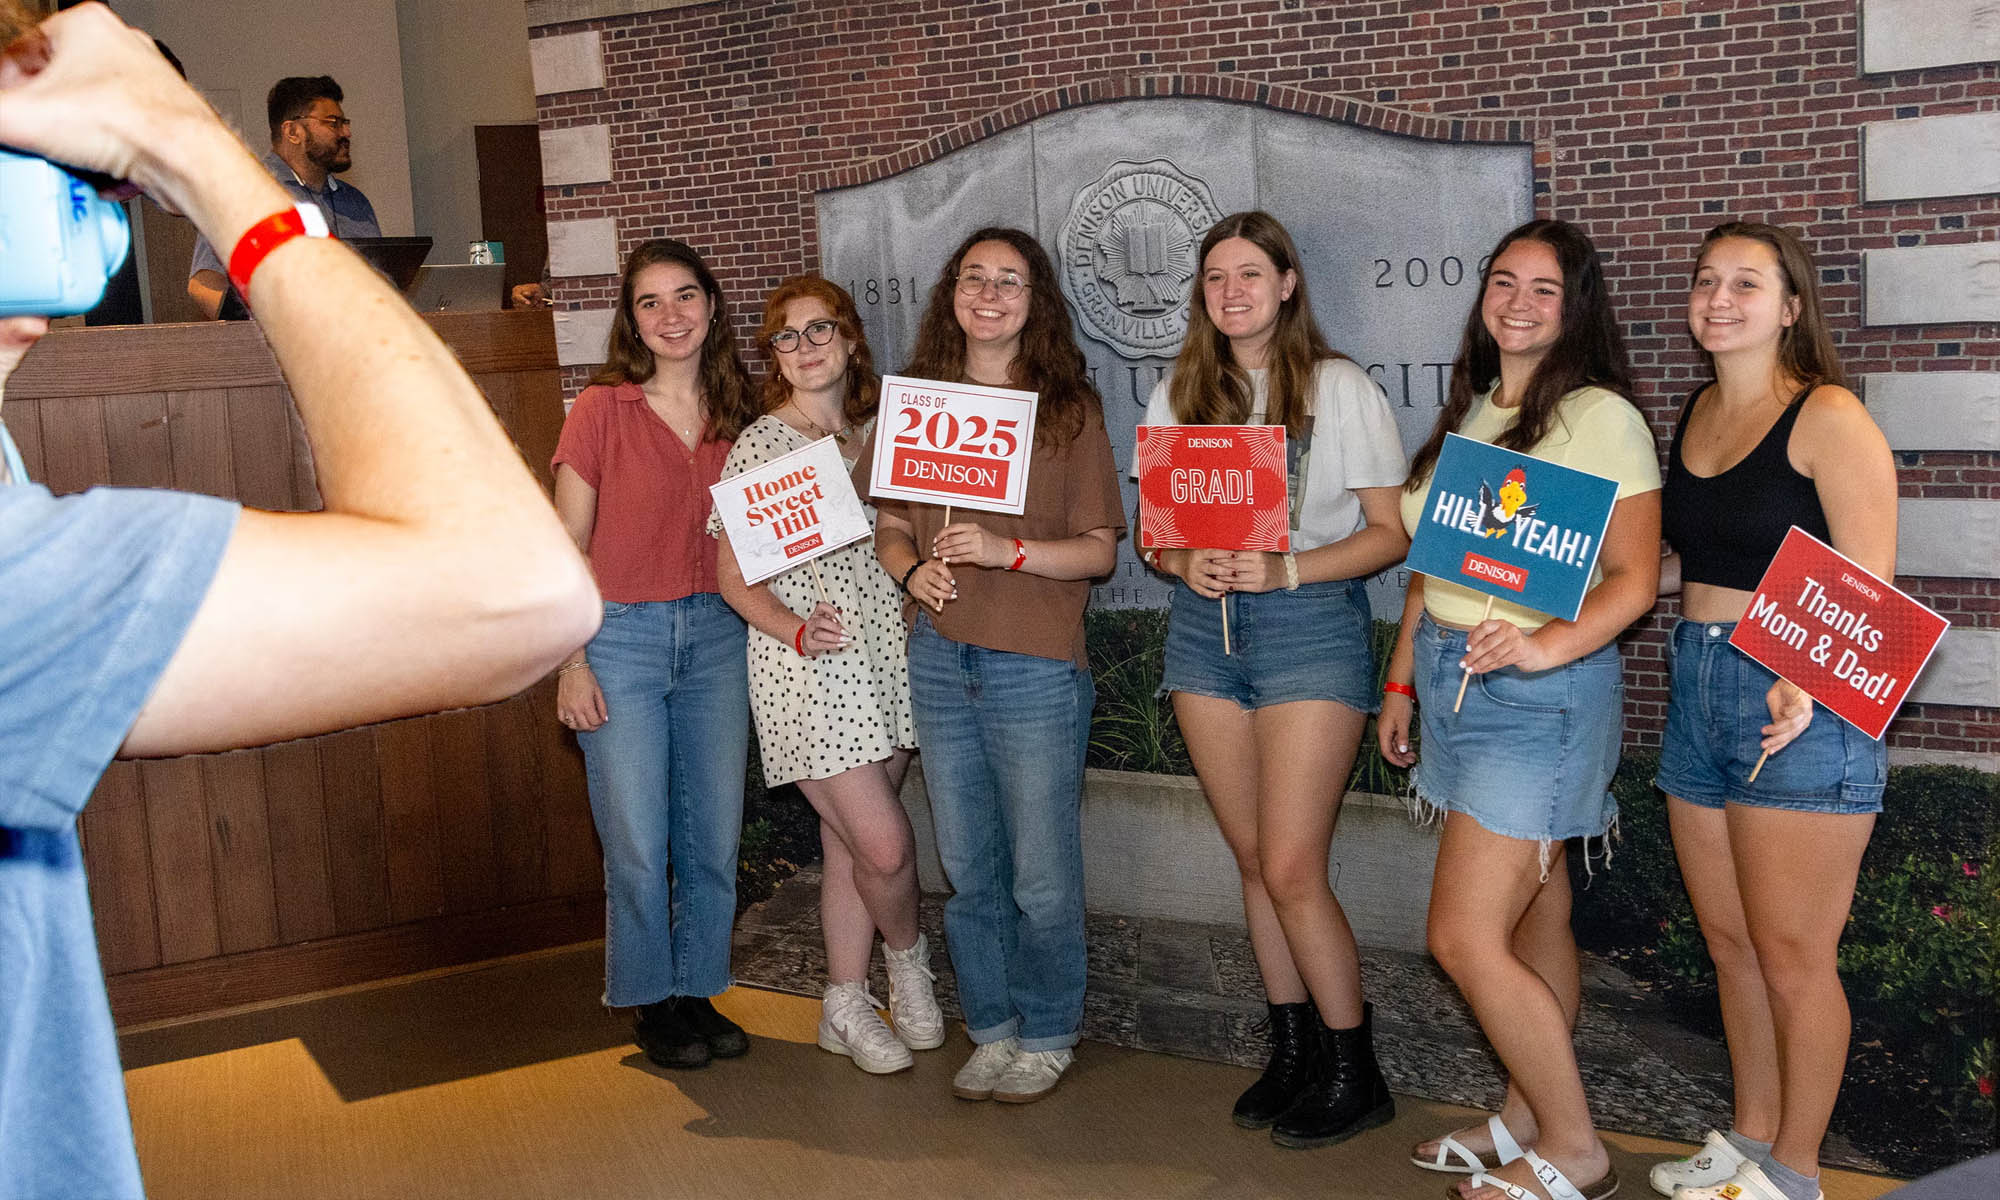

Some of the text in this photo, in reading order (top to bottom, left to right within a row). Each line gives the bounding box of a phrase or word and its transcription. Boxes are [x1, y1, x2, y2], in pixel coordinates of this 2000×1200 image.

[1075, 175, 1210, 268] DENISON UNIVERSI
[850, 277, 918, 305] 1831
[901, 393, 947, 408] CLASS OF
[894, 407, 1019, 457] 2025
[1188, 438, 1232, 448] DENISON
[743, 465, 817, 505] Home
[903, 458, 998, 488] DENISON
[1170, 468, 1253, 504] GRAD!
[745, 482, 824, 527] Sweet
[771, 505, 820, 540] Hill
[1432, 490, 1591, 568] HILL YEAH!
[788, 536, 820, 554] DENISON
[1468, 559, 1521, 585] DENISON
[1841, 572, 1881, 602] DENISON
[1796, 576, 1883, 652] Thanks
[1748, 593, 1897, 705] Mom & Dad!
